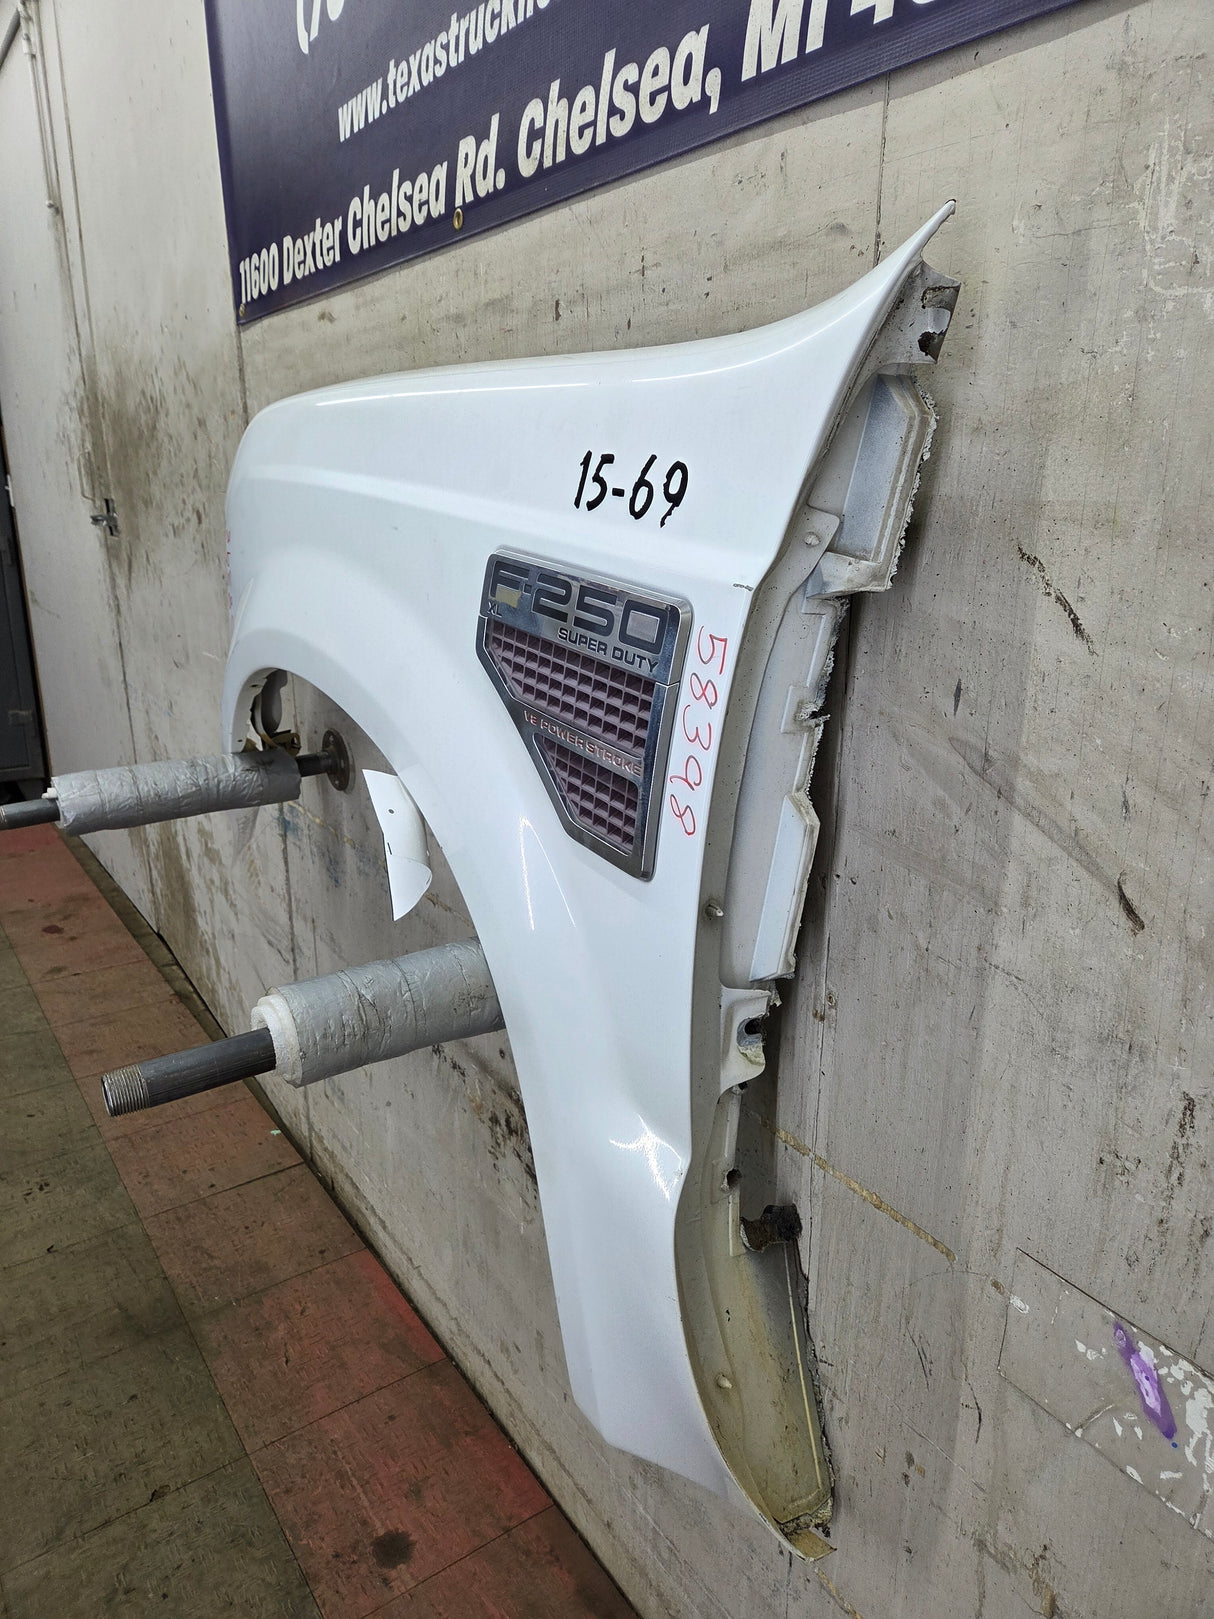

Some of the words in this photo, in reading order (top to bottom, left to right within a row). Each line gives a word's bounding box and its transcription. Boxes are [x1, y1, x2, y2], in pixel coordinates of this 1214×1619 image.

[239, 242, 280, 305] 11600
[283, 215, 343, 286] Dexter
[347, 161, 448, 255] Chelsea
[454, 113, 506, 208] Rd.
[517, 23, 722, 178] Chelsea,
[573, 450, 689, 528] 15-69
[490, 560, 671, 655] F-250
[557, 627, 608, 656] SUPER
[611, 646, 659, 673] DUTY
[540, 719, 584, 749] POWER
[585, 740, 642, 777] STROKE
